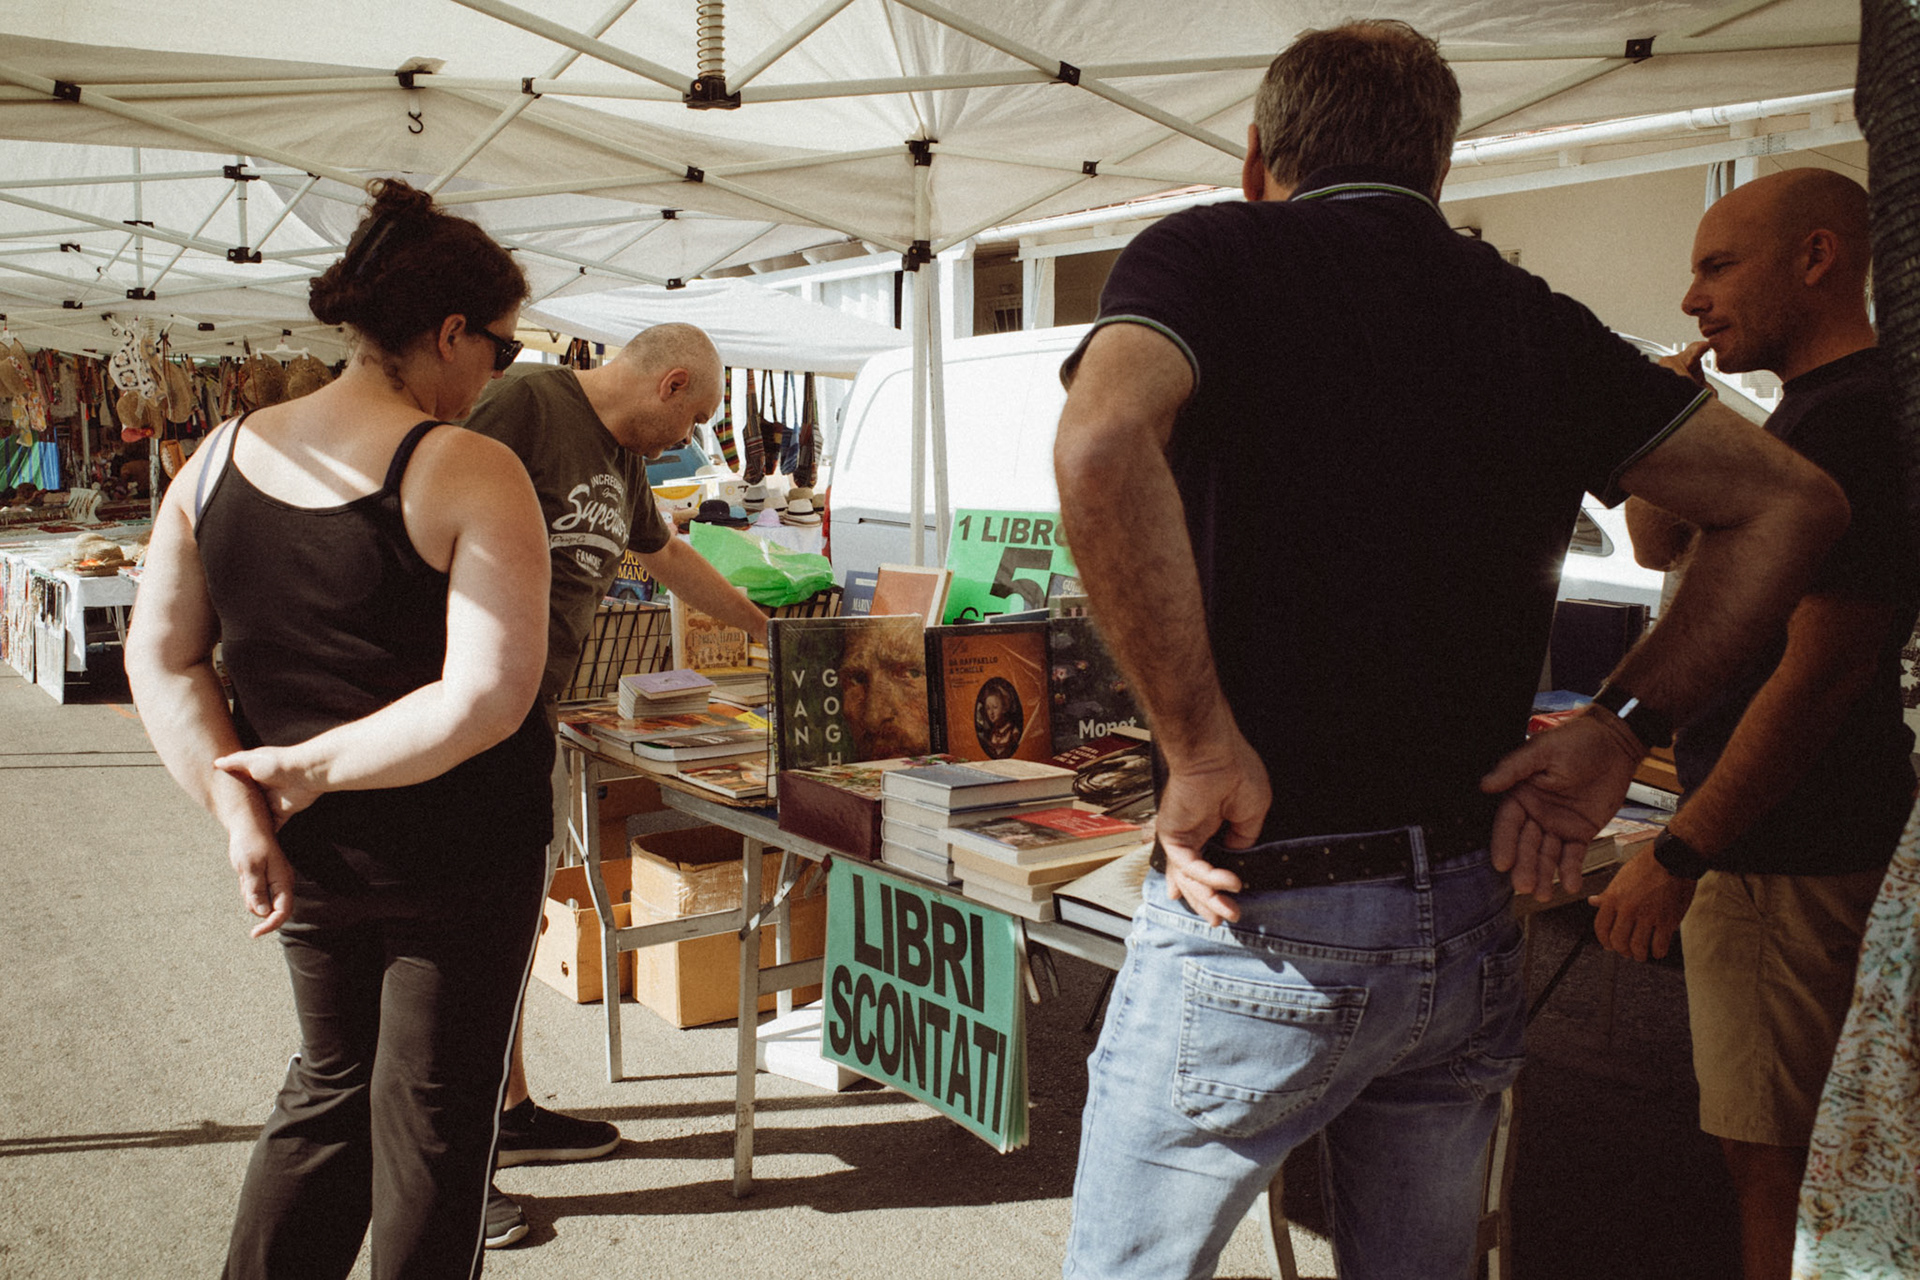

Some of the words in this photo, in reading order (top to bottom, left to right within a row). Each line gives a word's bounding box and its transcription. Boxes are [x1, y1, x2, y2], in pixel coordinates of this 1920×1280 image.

[958, 515, 972, 541] 1
[989, 546, 1053, 611] 5
[791, 670, 809, 745] VAN
[822, 668, 842, 766] GOGH
[853, 873, 985, 1013] LIBRI
[829, 965, 1007, 1135] SCONTATI
